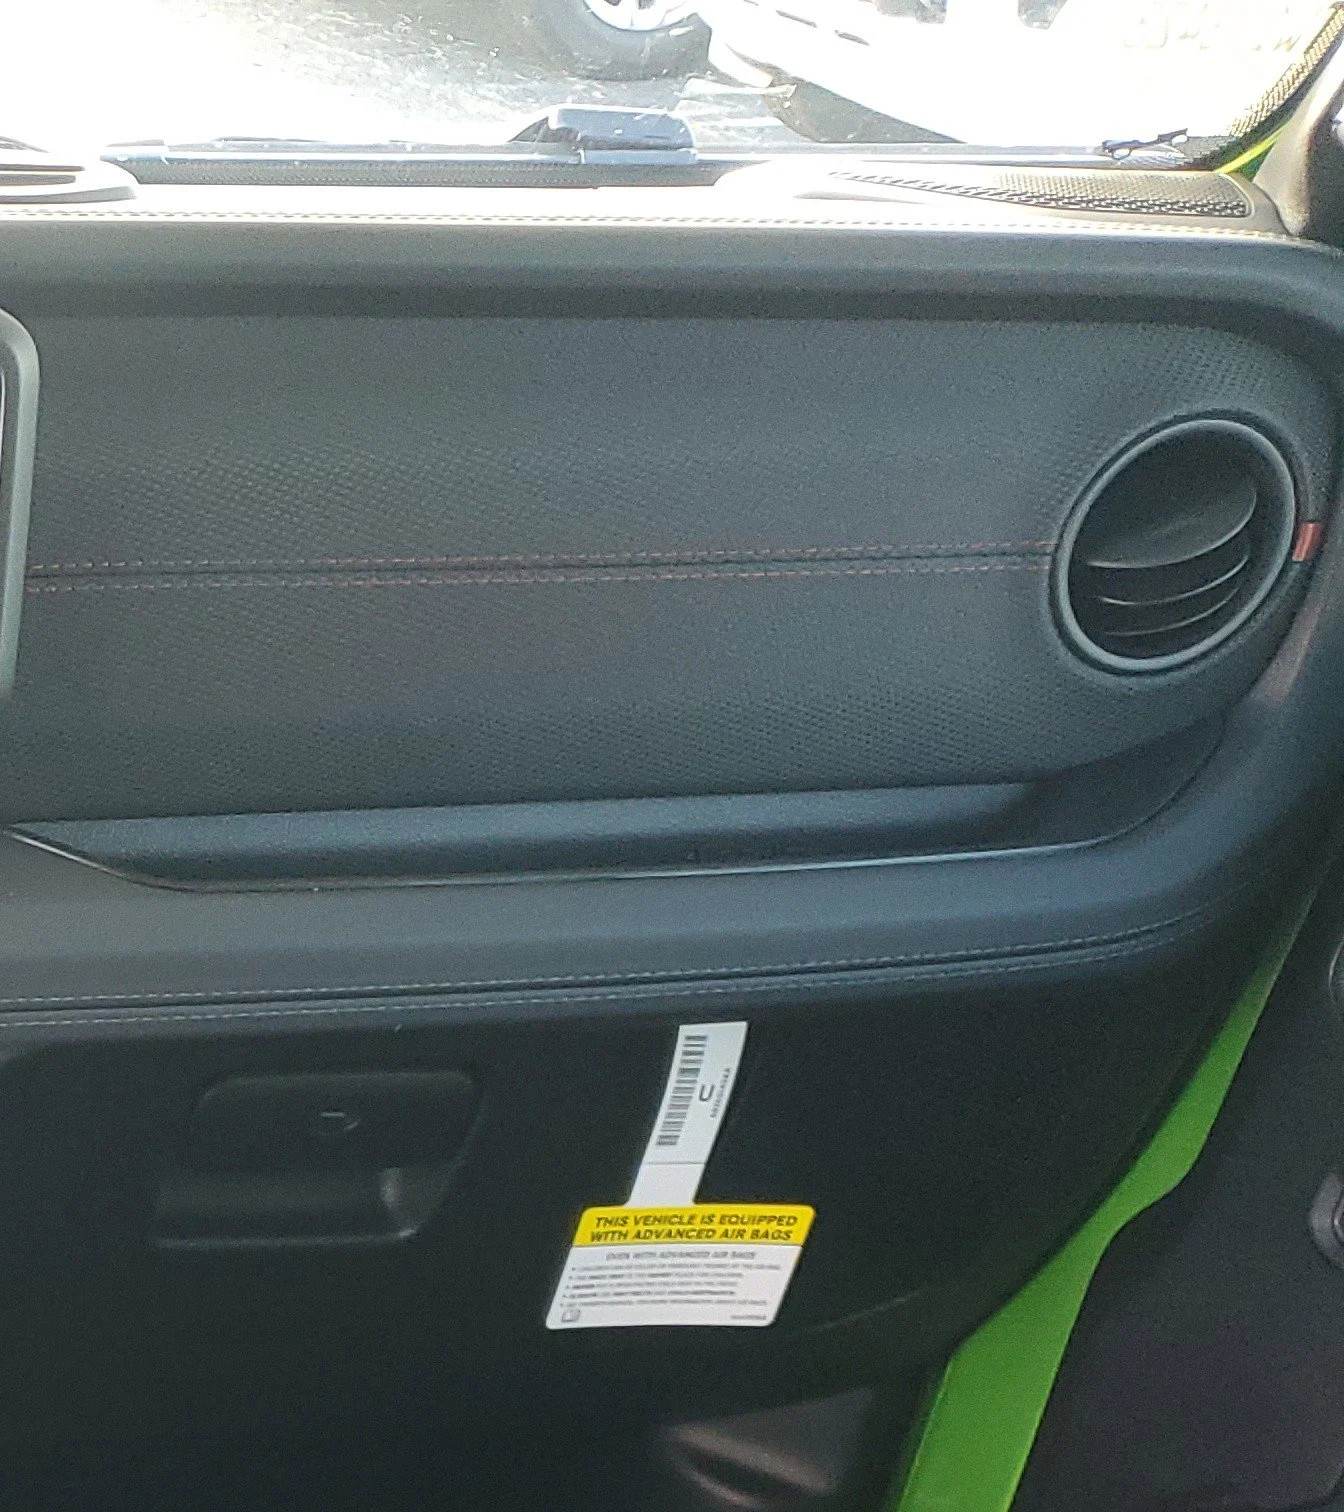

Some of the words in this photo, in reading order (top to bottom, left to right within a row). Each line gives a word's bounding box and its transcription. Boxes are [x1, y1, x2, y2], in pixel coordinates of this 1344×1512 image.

[698, 1083, 715, 1102] U
[595, 1216, 629, 1228] THIS
[633, 1214, 695, 1226] VEHICLE
[699, 1213, 714, 1225] IS
[718, 1214, 799, 1226] EQUIPPED
[590, 1230, 628, 1242] WITH
[631, 1229, 716, 1241] ADVANCED
[720, 1229, 746, 1240] AIR
[751, 1229, 793, 1241] BAGS
